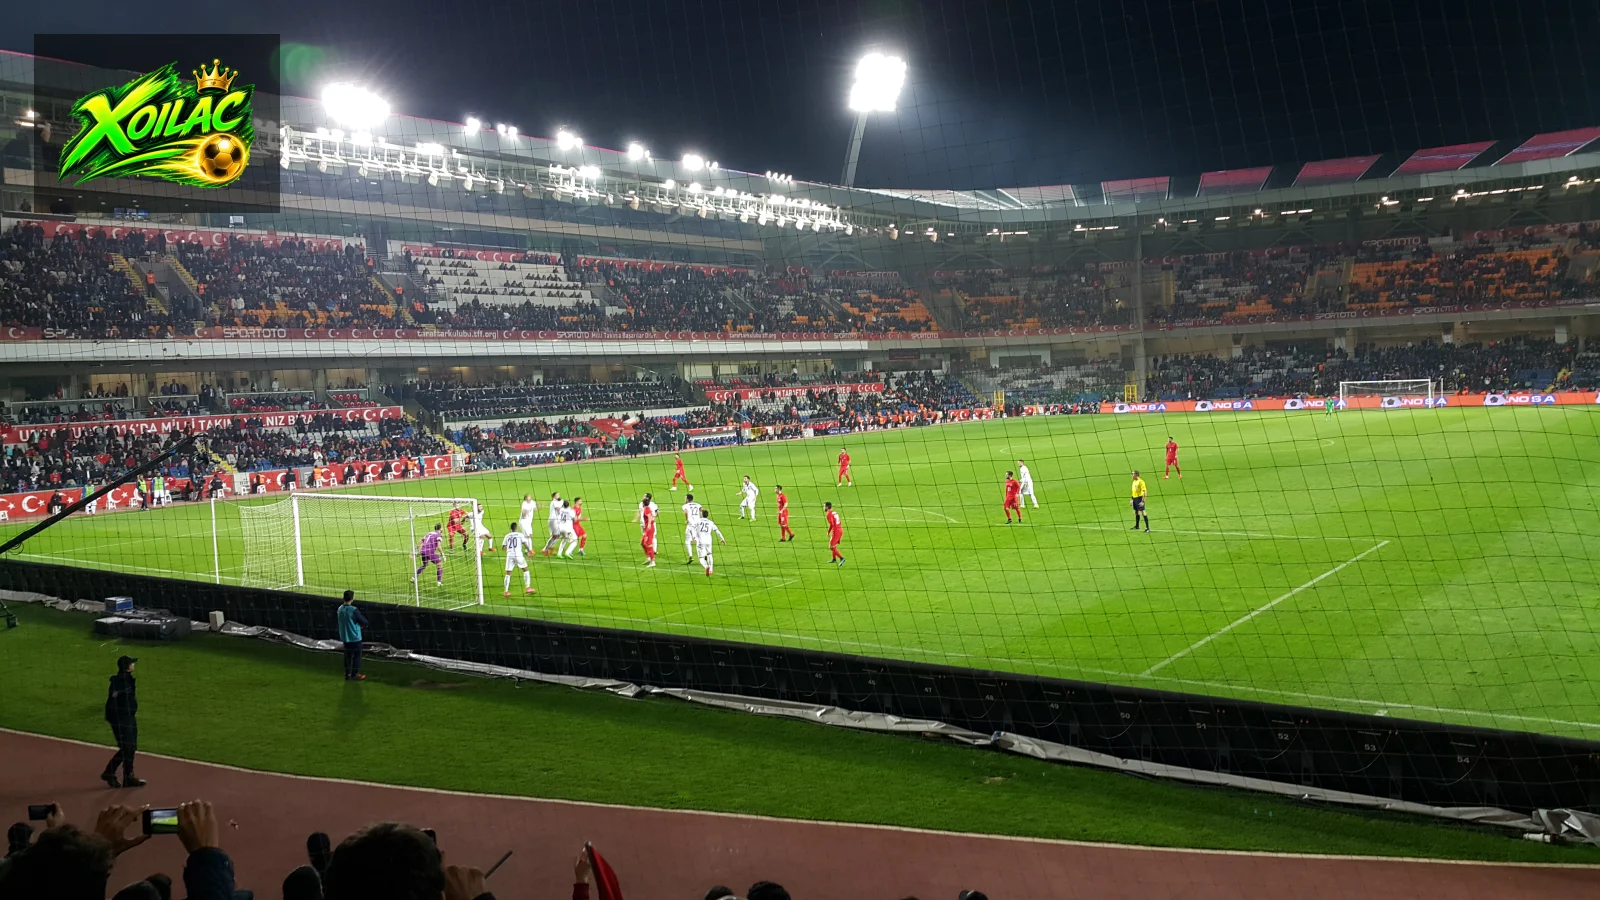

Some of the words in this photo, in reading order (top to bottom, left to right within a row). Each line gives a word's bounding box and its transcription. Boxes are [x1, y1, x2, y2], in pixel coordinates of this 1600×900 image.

[223, 328, 287, 338] SPORTOTO
[557, 331, 590, 339] SPORTOTO
[699, 521, 709, 533] 25
[507, 537, 518, 549] 20
[1119, 711, 1131, 720] 50
[1277, 732, 1290, 741] 52
[1364, 743, 1377, 752] 53
[1456, 755, 1471, 765] 54
